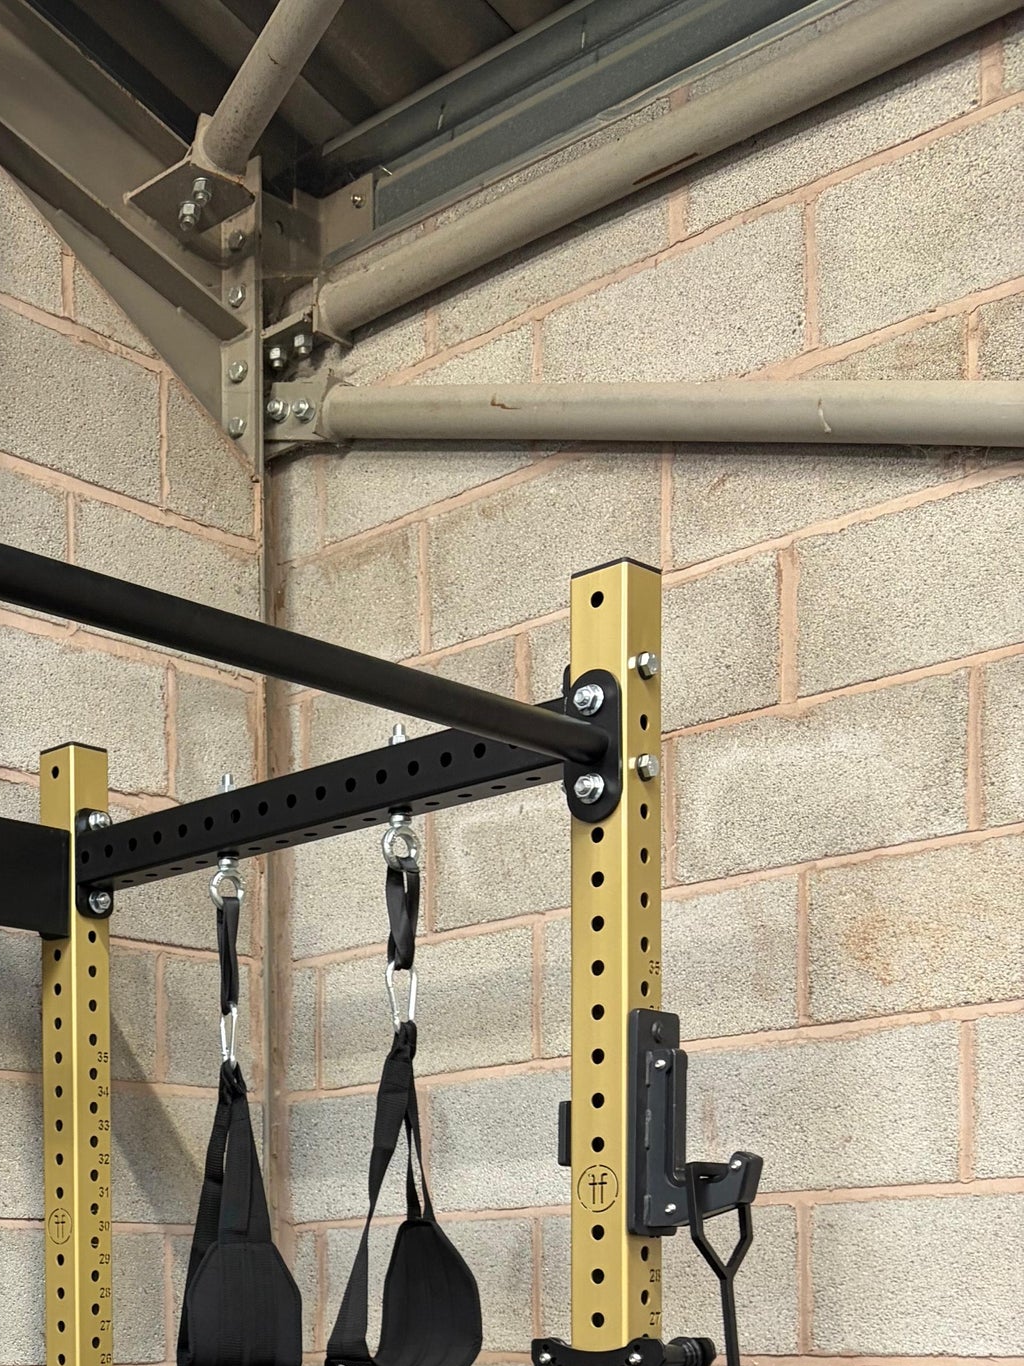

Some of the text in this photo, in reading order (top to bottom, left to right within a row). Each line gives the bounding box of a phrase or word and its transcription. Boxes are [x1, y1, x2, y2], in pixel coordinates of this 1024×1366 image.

[98, 1052, 108, 1062] 35
[98, 1086, 109, 1097] 34
[98, 1120, 110, 1130] 33
[99, 1154, 110, 1164] 32
[99, 1187, 109, 1198] 31
[99, 1221, 110, 1232] 30
[99, 1254, 110, 1264] 29
[650, 1312, 661, 1325] 27
[100, 1320, 111, 1331] 27
[100, 1354, 112, 1364] 26
